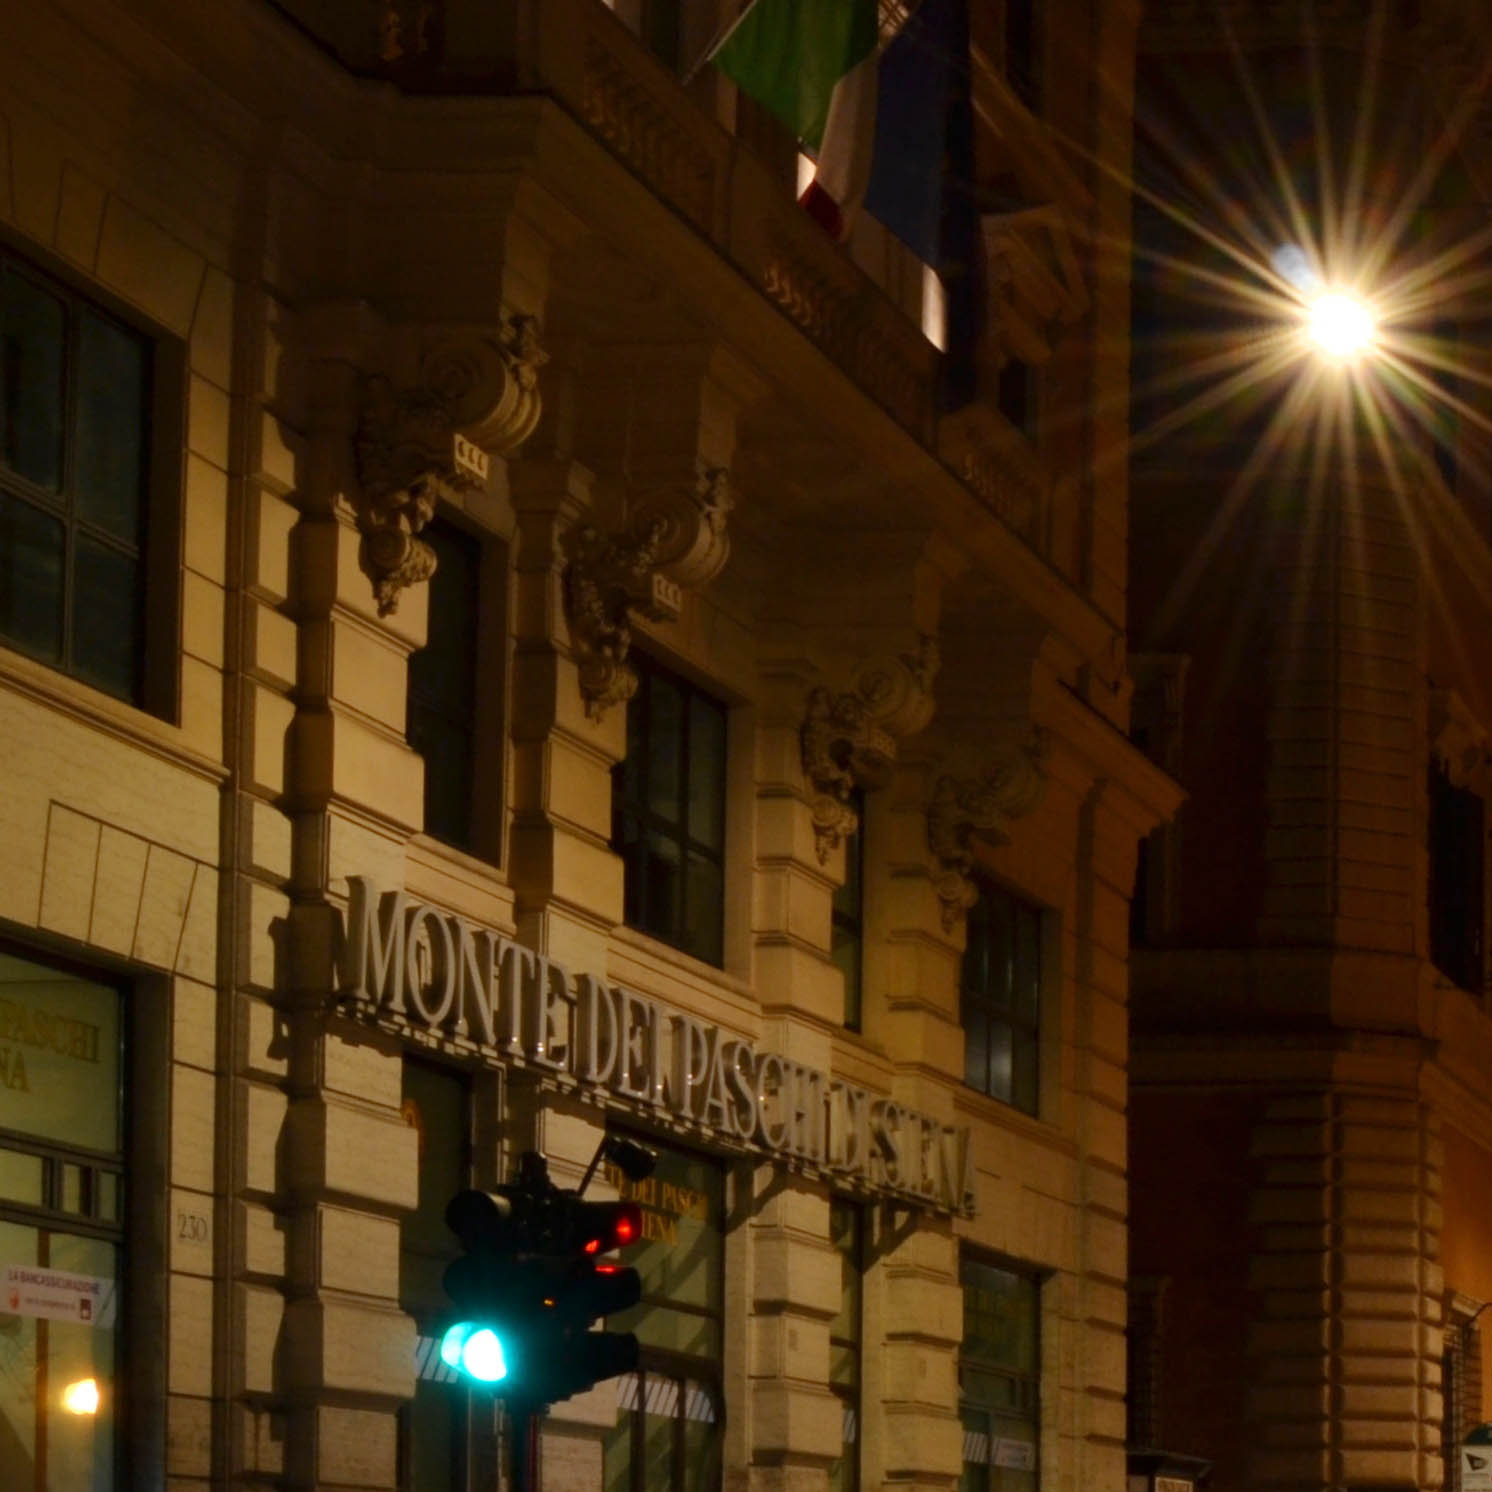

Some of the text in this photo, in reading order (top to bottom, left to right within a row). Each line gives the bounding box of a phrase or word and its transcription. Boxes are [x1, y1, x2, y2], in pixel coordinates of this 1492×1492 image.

[346, 875, 978, 1212] MONTE DEI PASCHI DI SIENA
[178, 1214, 208, 1241] 230
